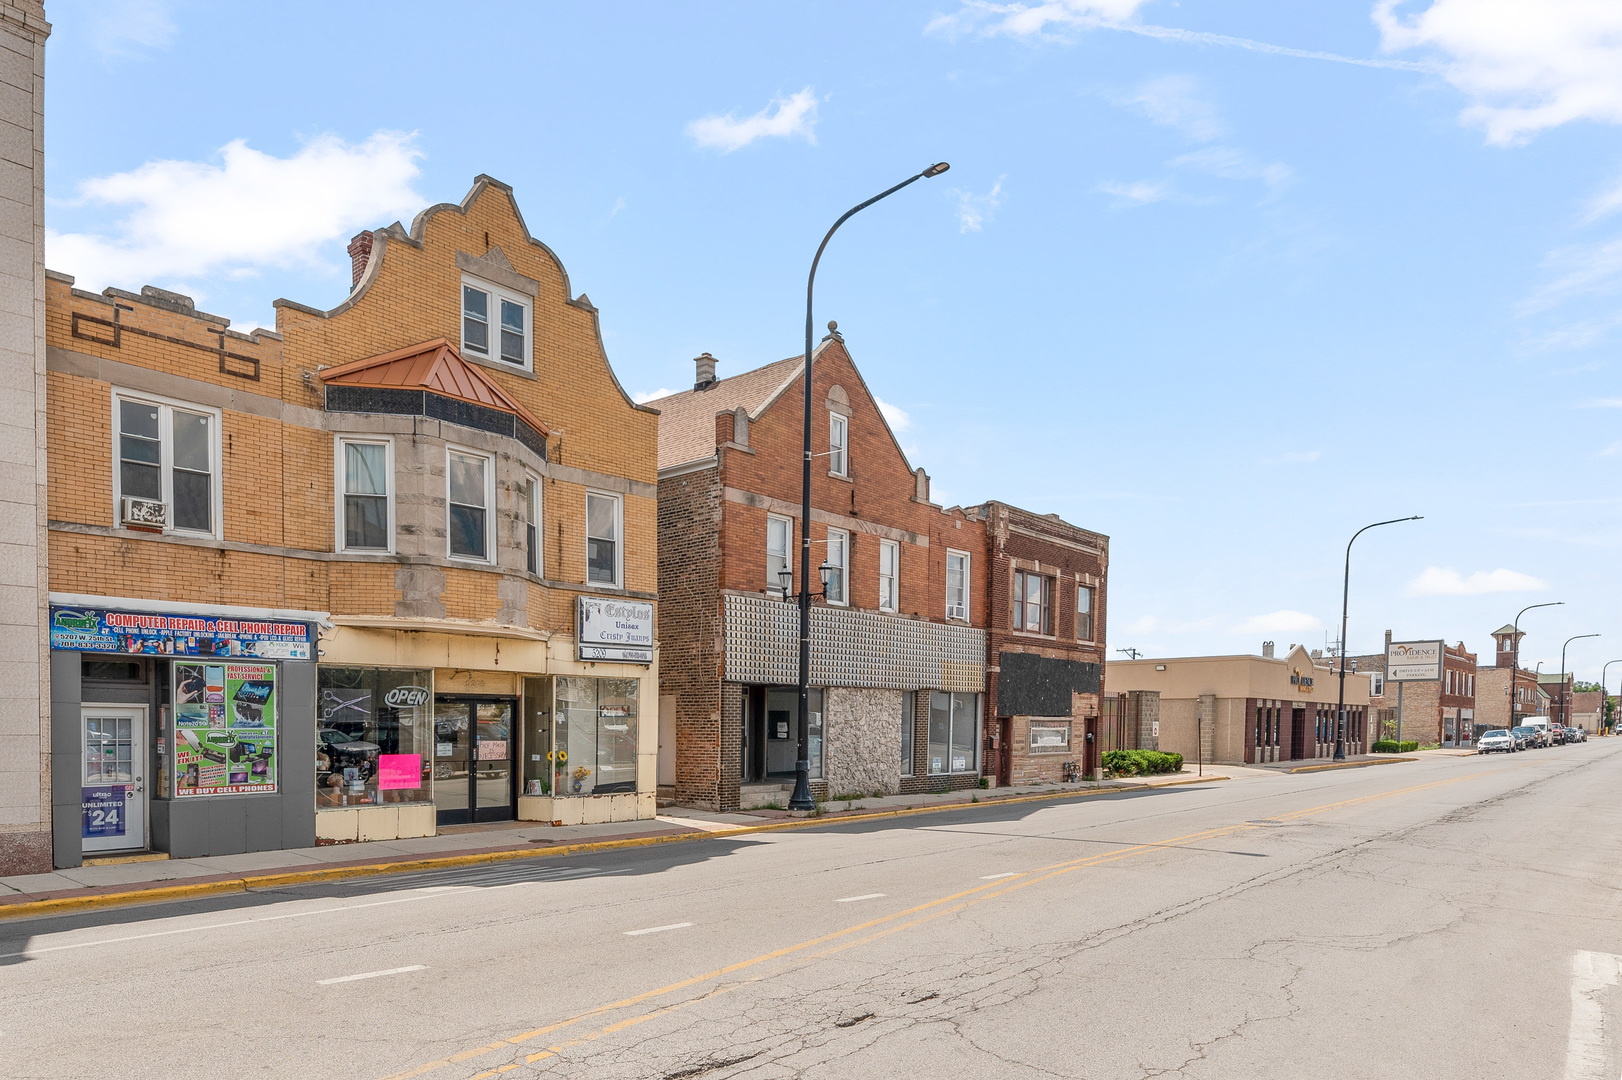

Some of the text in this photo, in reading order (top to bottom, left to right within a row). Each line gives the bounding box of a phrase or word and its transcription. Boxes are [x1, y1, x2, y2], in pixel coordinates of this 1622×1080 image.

[106, 613, 306, 636] COMPUTER REPAIR & CELL PHONE REPAIR
[615, 621, 639, 630] Unisex
[60, 641, 116, 650] 708-833-3320
[1390, 645, 1437, 656] PROVIDENCE
[227, 665, 266, 673] PROFESSIONAL
[388, 689, 426, 705] OPEN
[191, 755, 203, 763] IT!
[239, 784, 274, 792] PHONES
